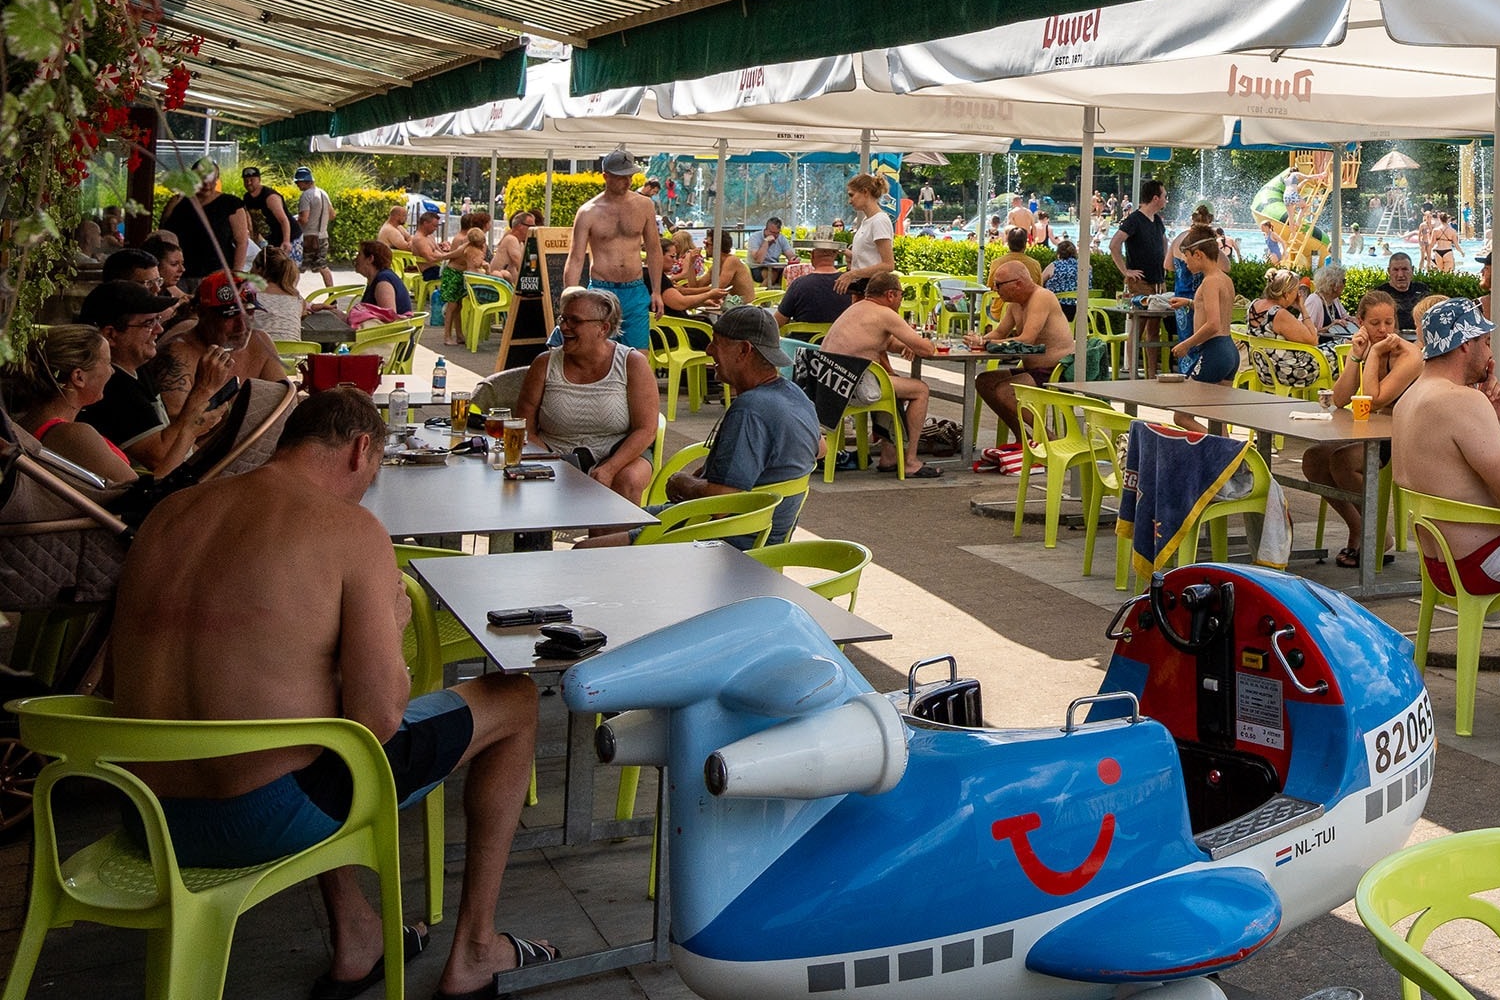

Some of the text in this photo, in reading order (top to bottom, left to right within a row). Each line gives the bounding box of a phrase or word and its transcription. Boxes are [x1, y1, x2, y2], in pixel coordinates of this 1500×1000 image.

[1042, 8, 1102, 50] Duvel
[544, 239, 569, 249] GEUZE
[520, 282, 539, 290] BOON
[1375, 694, 1434, 774] 82065
[1295, 826, 1336, 857] NL-TUI
